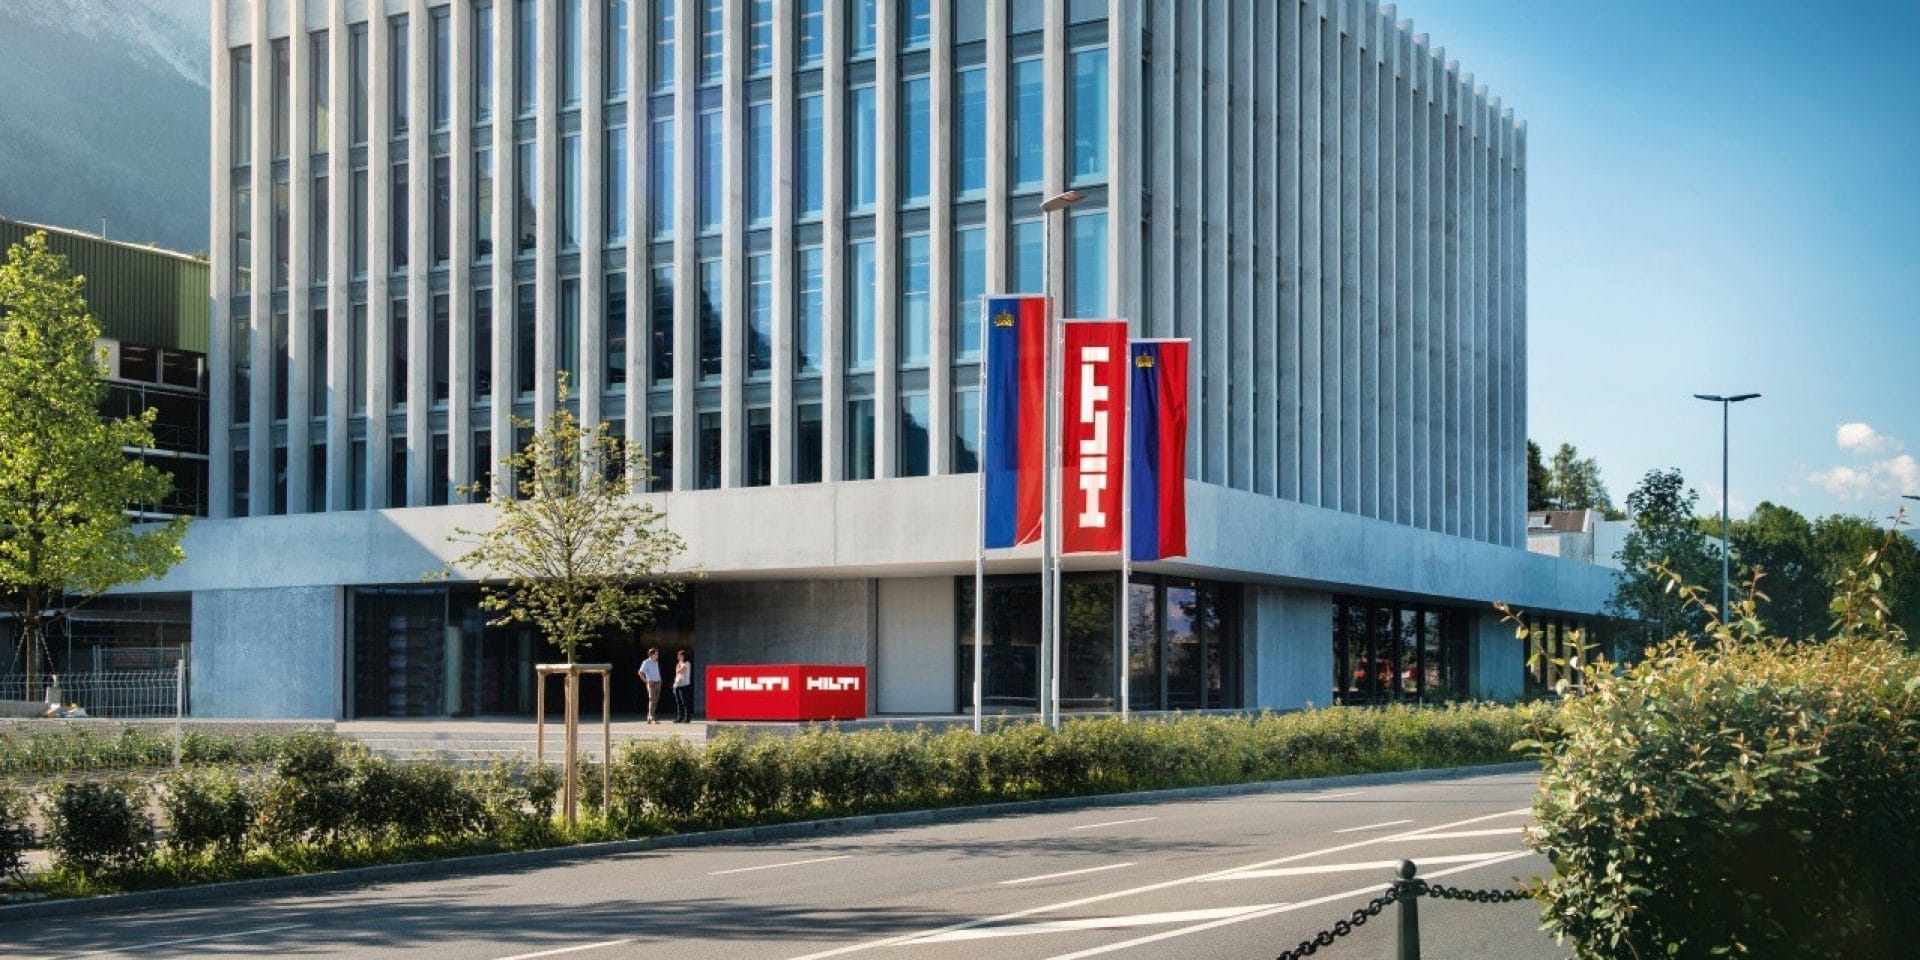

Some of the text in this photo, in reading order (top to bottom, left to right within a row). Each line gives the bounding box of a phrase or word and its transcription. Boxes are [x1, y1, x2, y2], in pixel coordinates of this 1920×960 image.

[1079, 347, 1109, 527] HILTI
[717, 677, 789, 690] HILTI
[807, 677, 859, 690] HILTI
